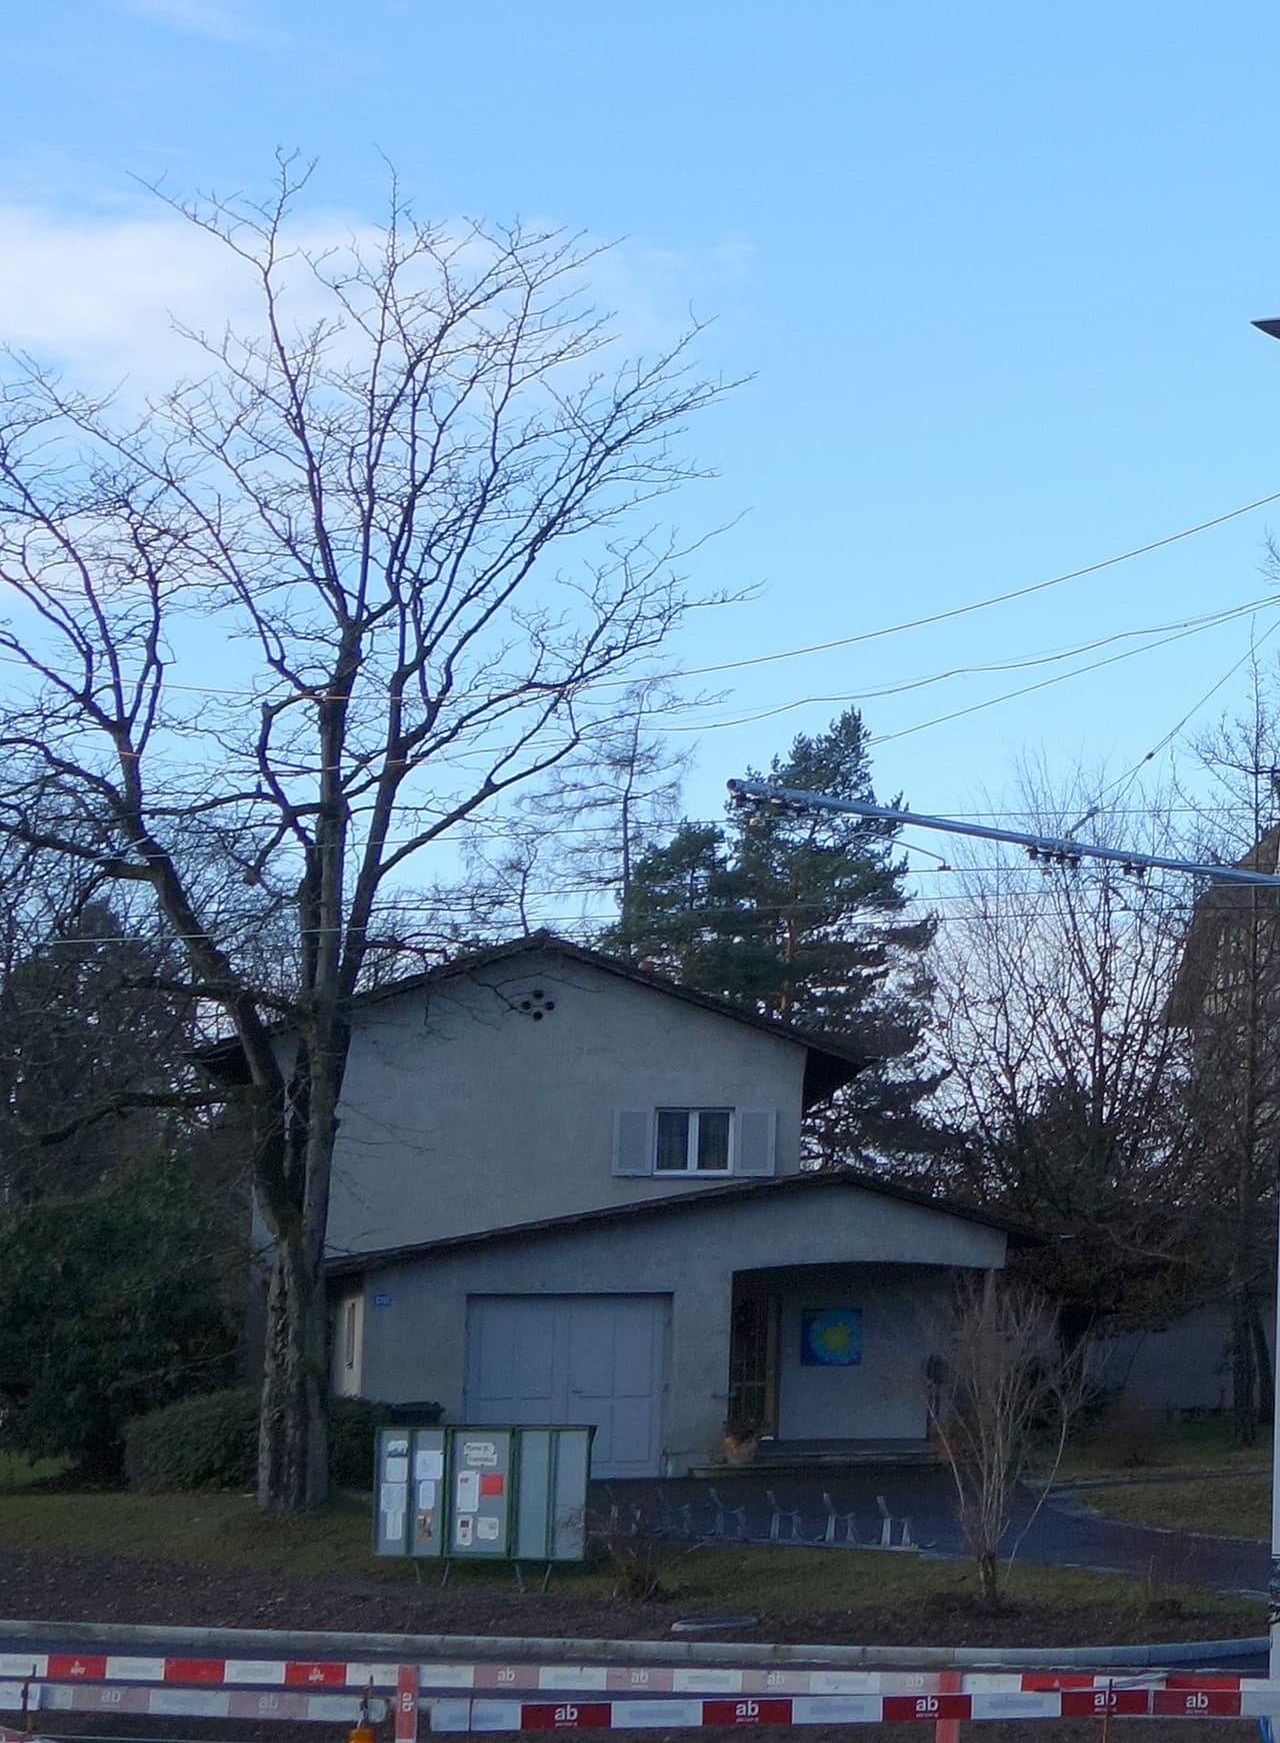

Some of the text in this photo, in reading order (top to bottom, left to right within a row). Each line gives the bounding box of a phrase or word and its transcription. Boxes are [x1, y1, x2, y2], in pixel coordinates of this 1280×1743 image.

[498, 1667, 515, 1681] ab
[631, 1668, 649, 1682] ab
[402, 1692, 414, 1712] ab
[916, 1695, 938, 1711] ab
[1094, 1691, 1116, 1706] ab
[1186, 1693, 1208, 1708] ab
[554, 1705, 578, 1721] ab
[735, 1701, 759, 1717] ab
